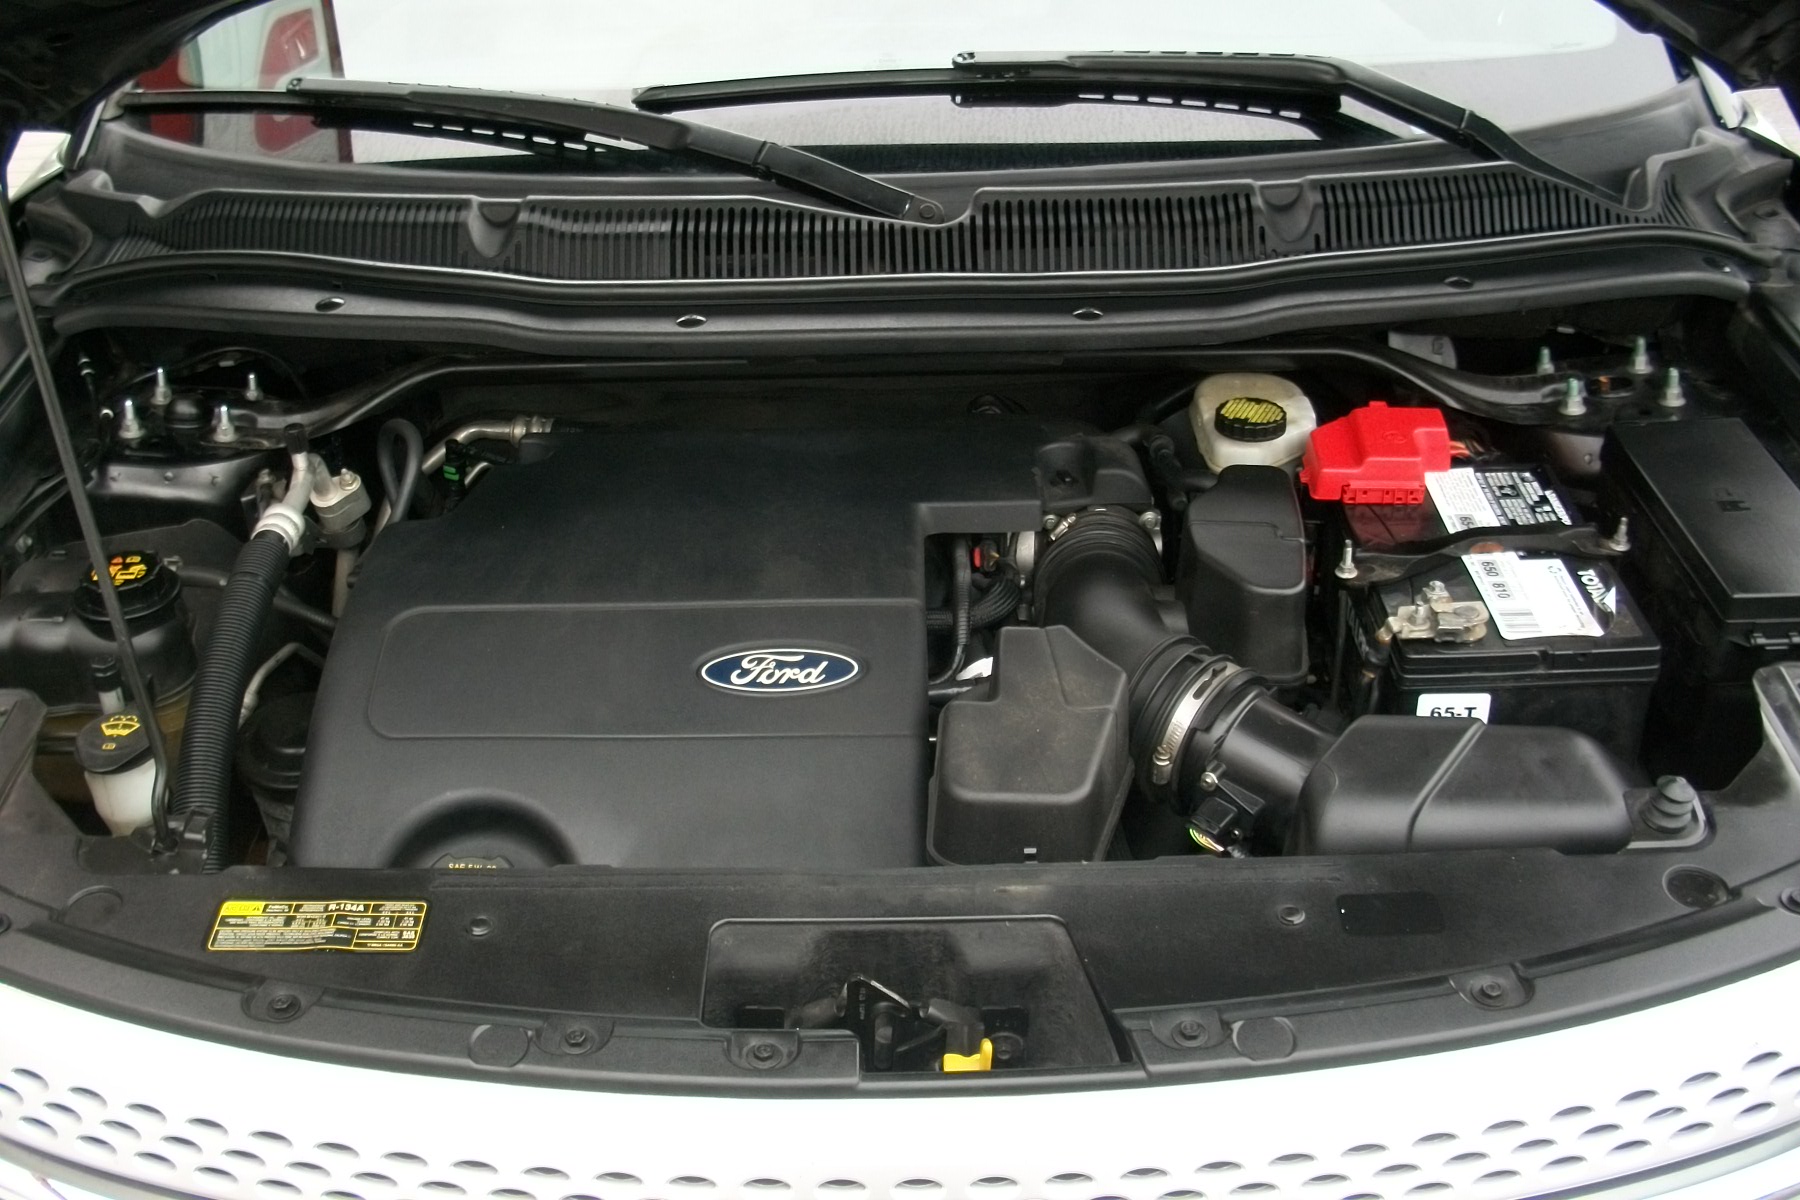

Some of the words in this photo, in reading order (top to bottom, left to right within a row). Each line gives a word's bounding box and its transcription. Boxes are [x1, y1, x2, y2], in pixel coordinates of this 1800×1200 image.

[1481, 561, 1499, 577] 650
[1492, 582, 1511, 599] 810
[730, 654, 829, 685] Ford
[1430, 706, 1477, 718] 65-T
[328, 903, 365, 912] R-134A
